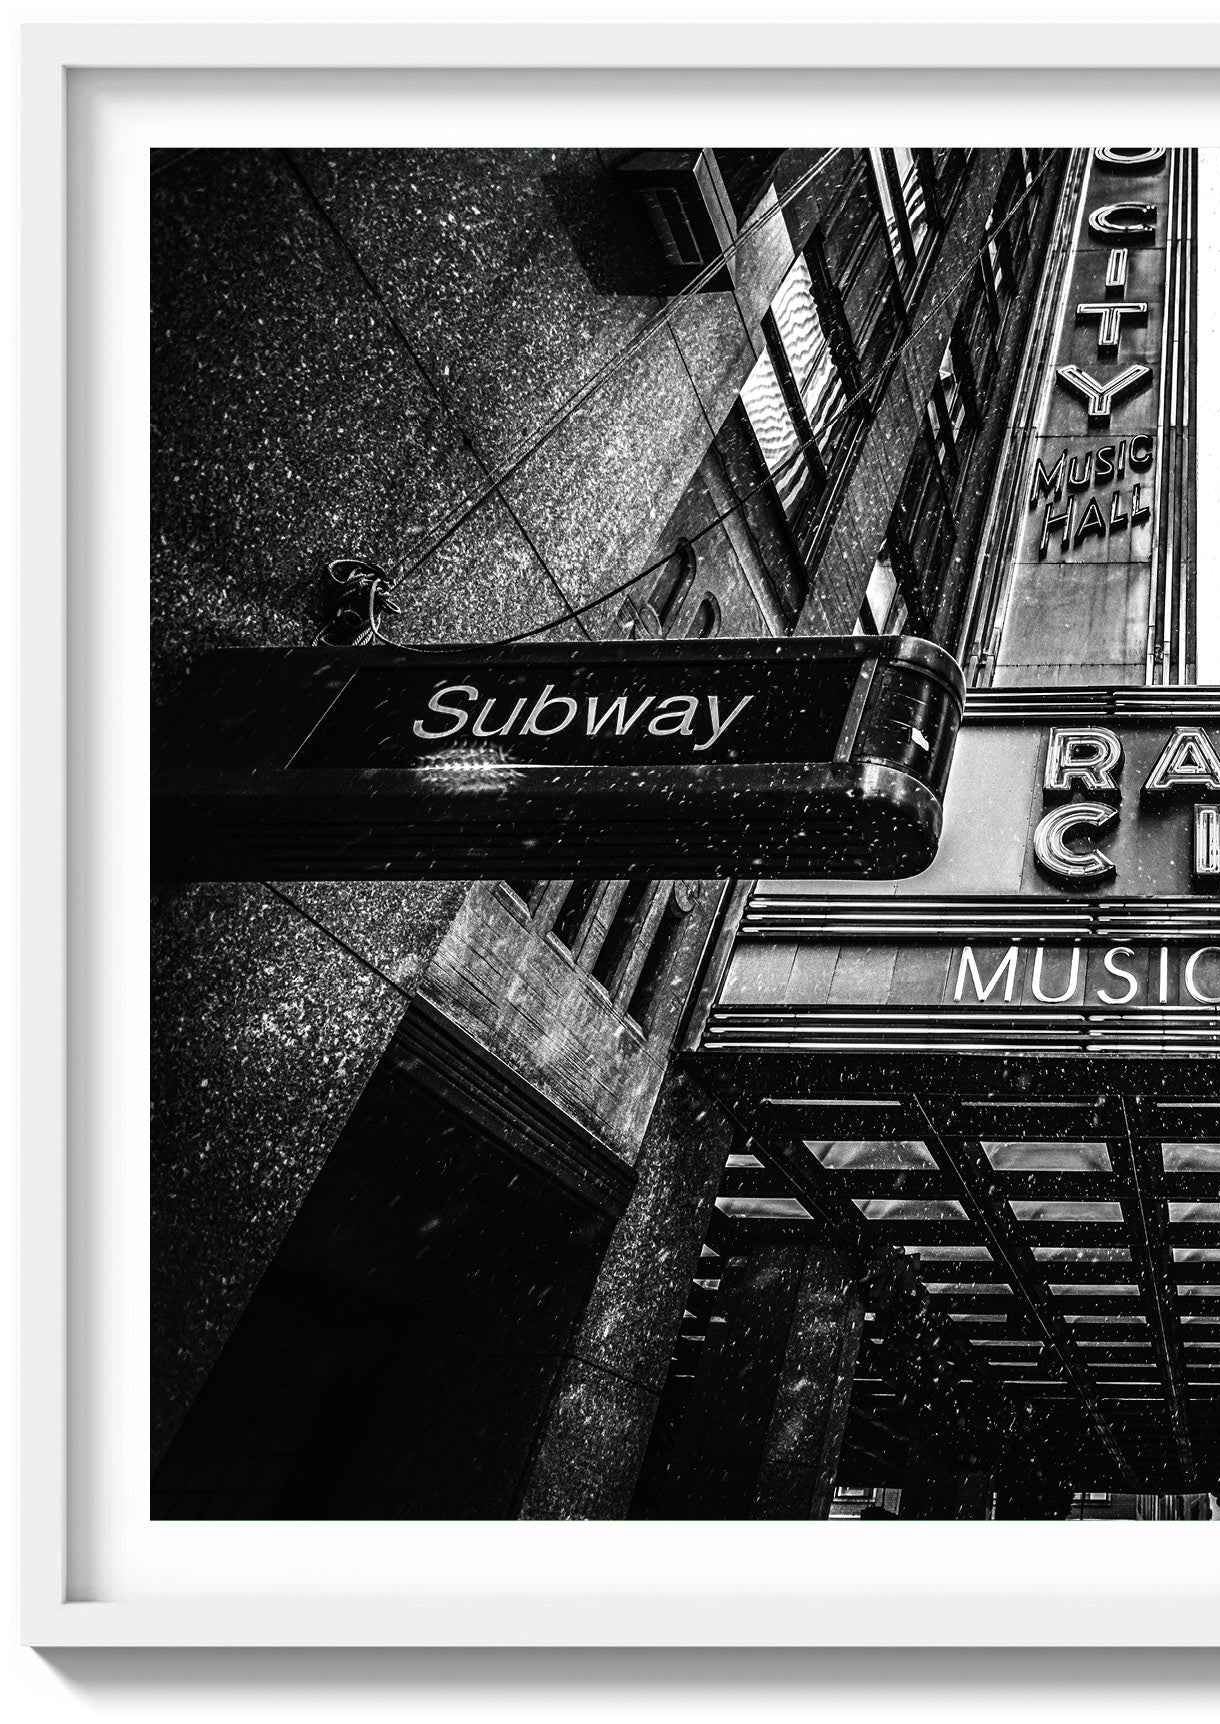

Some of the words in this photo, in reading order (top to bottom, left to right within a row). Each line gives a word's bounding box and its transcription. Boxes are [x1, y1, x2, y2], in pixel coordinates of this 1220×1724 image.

[1057, 202, 1157, 424] CITY
[1031, 434, 1153, 506] MUSIC
[1039, 484, 1150, 557] HALL
[413, 684, 754, 752] Subway
